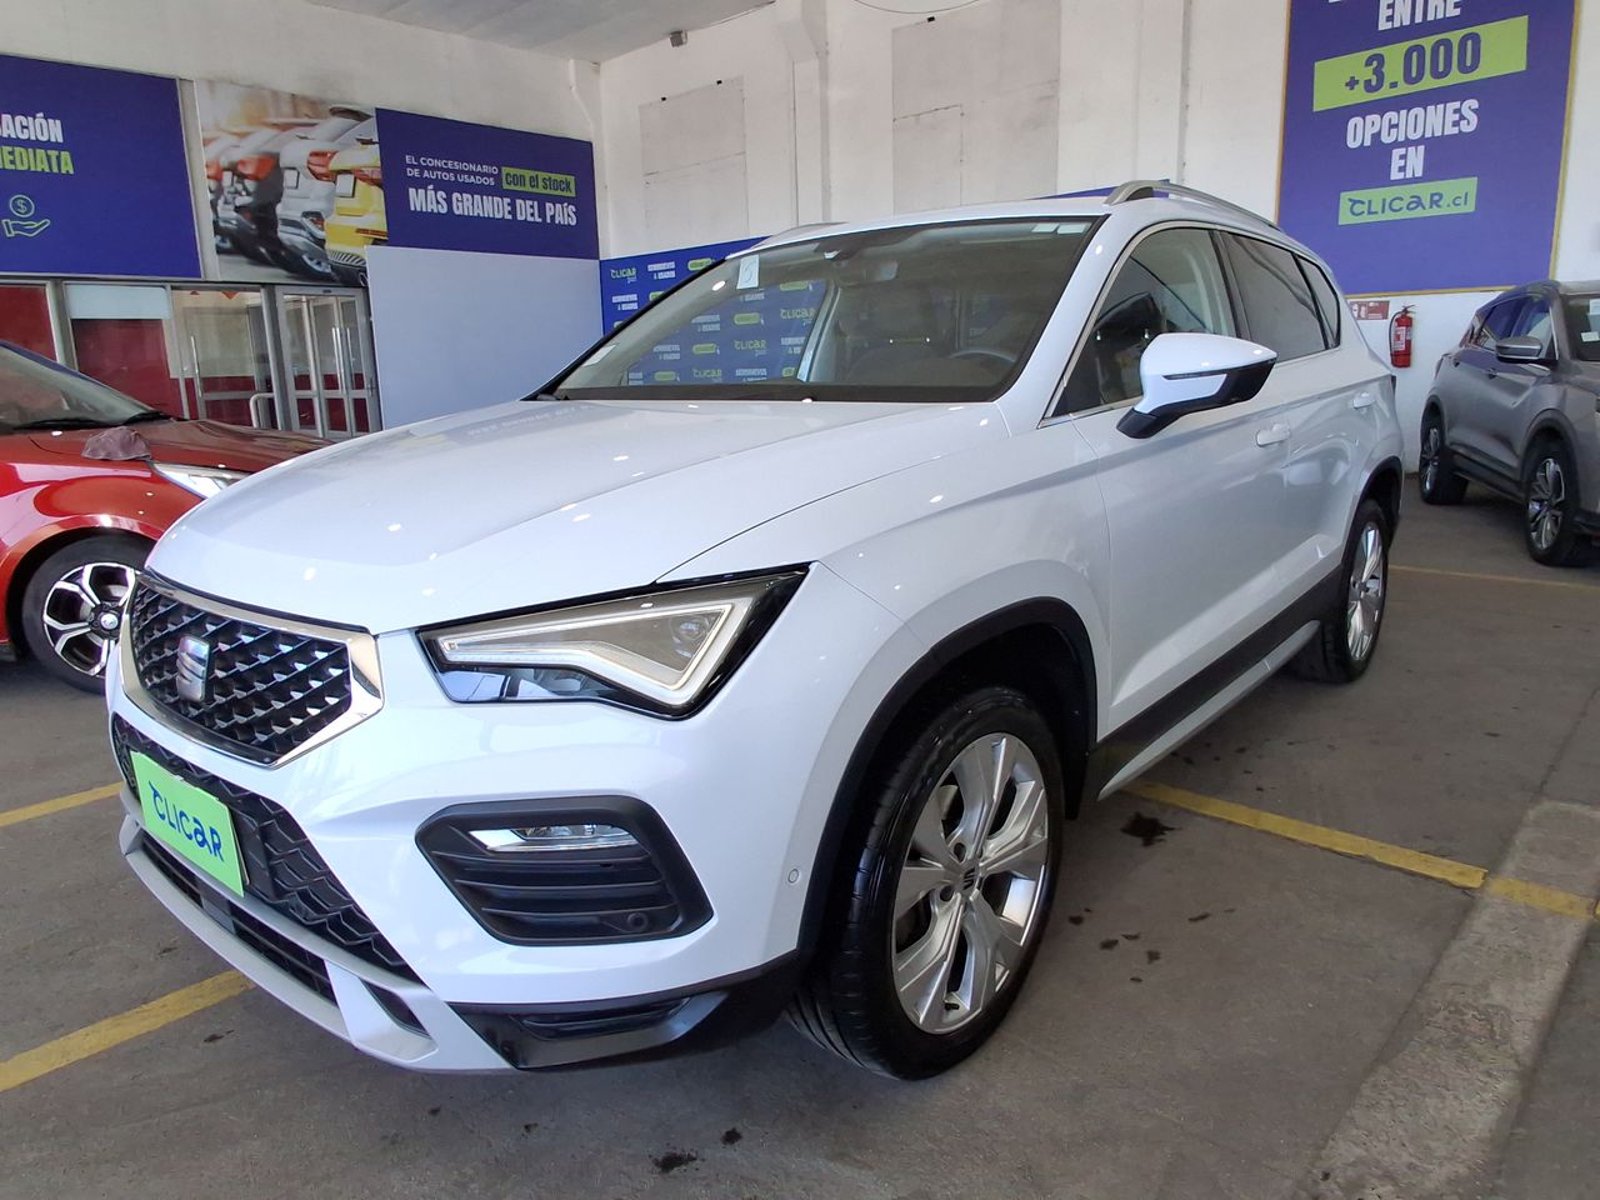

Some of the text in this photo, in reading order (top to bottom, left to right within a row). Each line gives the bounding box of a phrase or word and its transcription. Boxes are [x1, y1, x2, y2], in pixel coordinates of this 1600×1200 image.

[1378, 0, 1461, 31] ENTRE
[1345, 32, 1481, 93] +3.000
[0, 112, 64, 143] ACIÓN
[1346, 98, 1479, 148] OPCIONES
[0, 146, 75, 175] EDIATA
[405, 155, 499, 175] EL CONCESIONARIO
[1390, 145, 1425, 181] EN
[406, 168, 495, 186] DE AUTOS USADOS
[505, 171, 573, 194] con el stock
[408, 184, 577, 226] MÁS GRANDE DEL PAÍS
